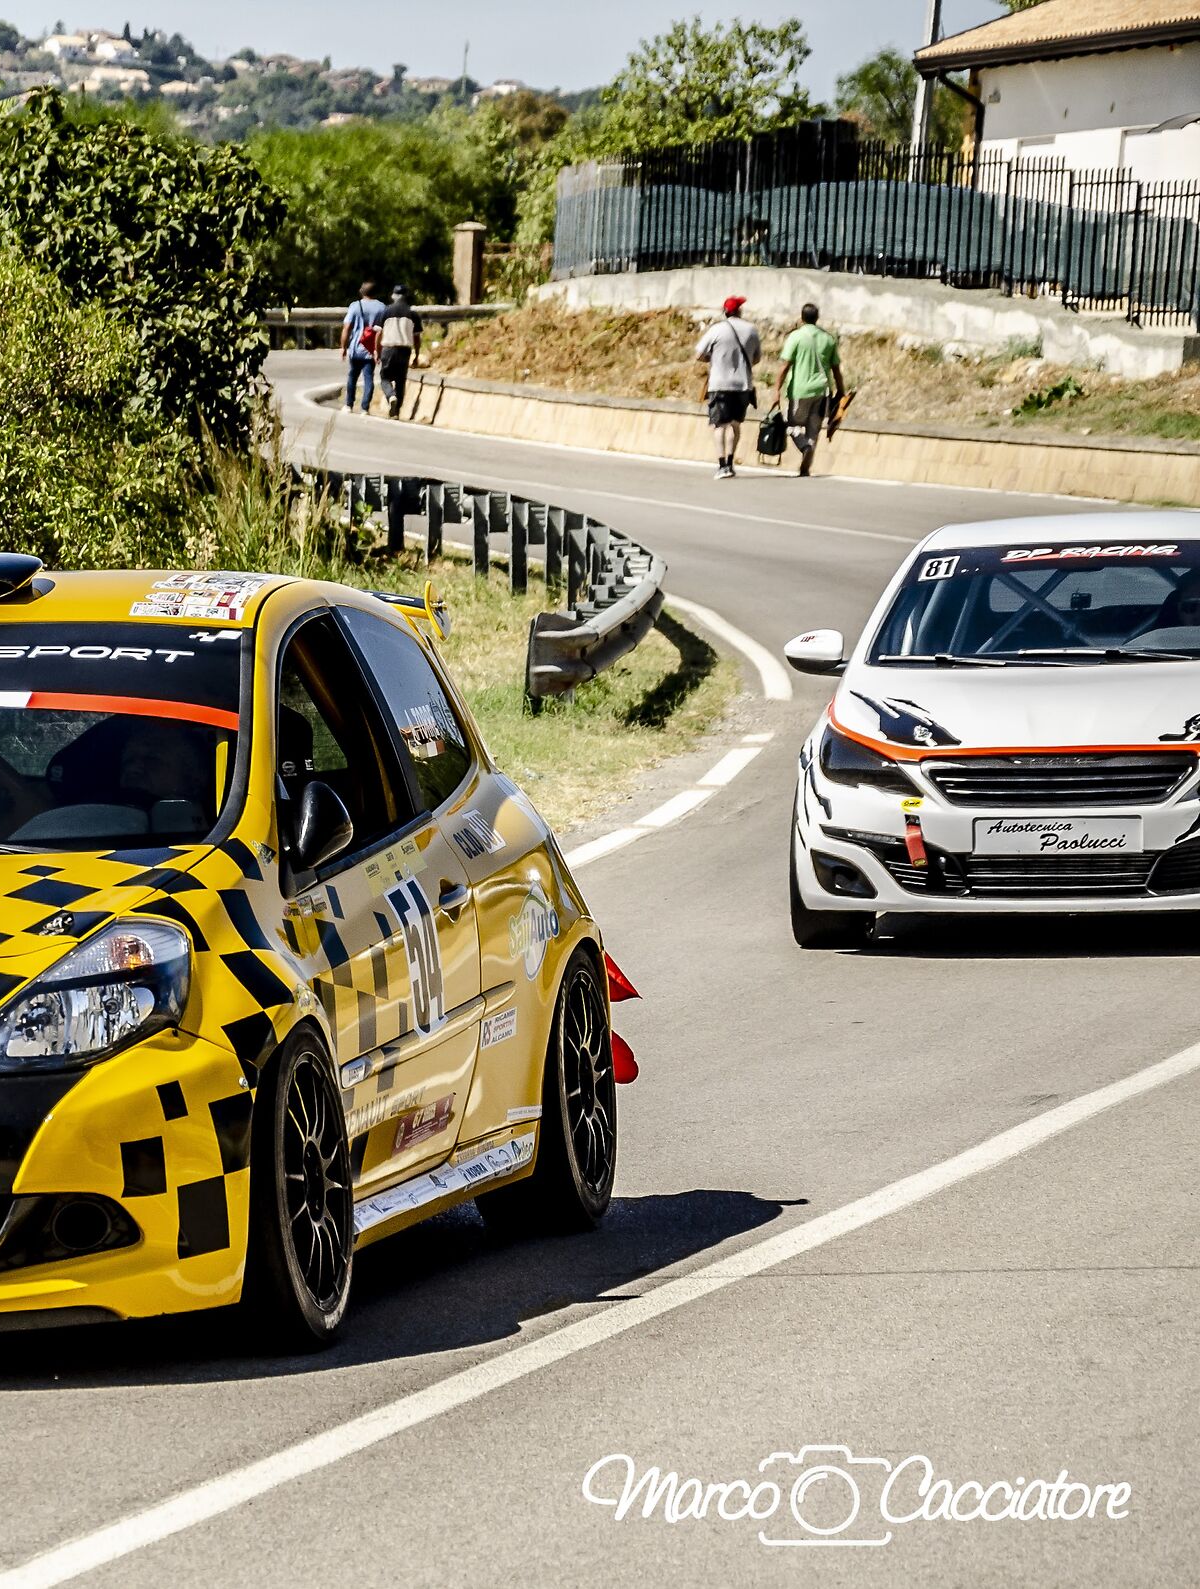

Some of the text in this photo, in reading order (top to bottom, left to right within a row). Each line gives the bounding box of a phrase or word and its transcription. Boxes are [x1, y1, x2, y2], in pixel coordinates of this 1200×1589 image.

[1001, 544, 1179, 561] DP RACING
[925, 557, 955, 579] 81
[987, 820, 1074, 835] Autotecnica
[453, 828, 485, 859] CLIO
[1039, 833, 1127, 852] Paolucci
[387, 879, 446, 1034] 54
[491, 1029, 513, 1043] ALCAMO
[466, 1163, 488, 1178] KOBRA
